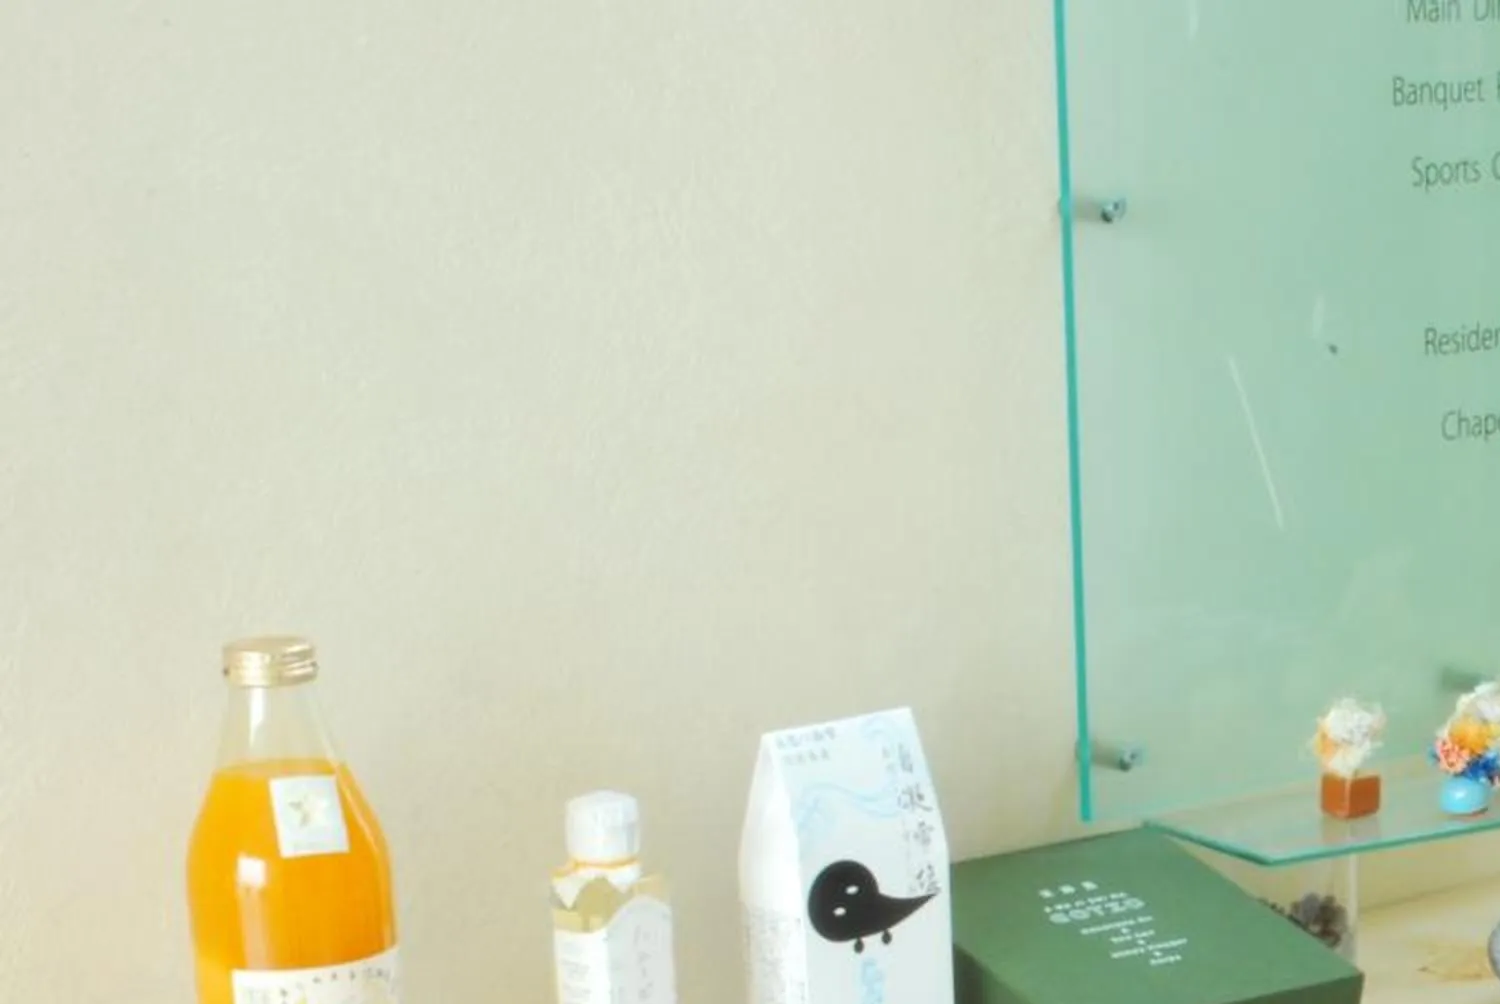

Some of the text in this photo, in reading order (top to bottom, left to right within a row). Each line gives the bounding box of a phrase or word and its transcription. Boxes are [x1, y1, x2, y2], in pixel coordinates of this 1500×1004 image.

[1406, 0, 1461, 23] Main
[1392, 75, 1485, 111] Banquet
[1411, 155, 1481, 192] Sports
